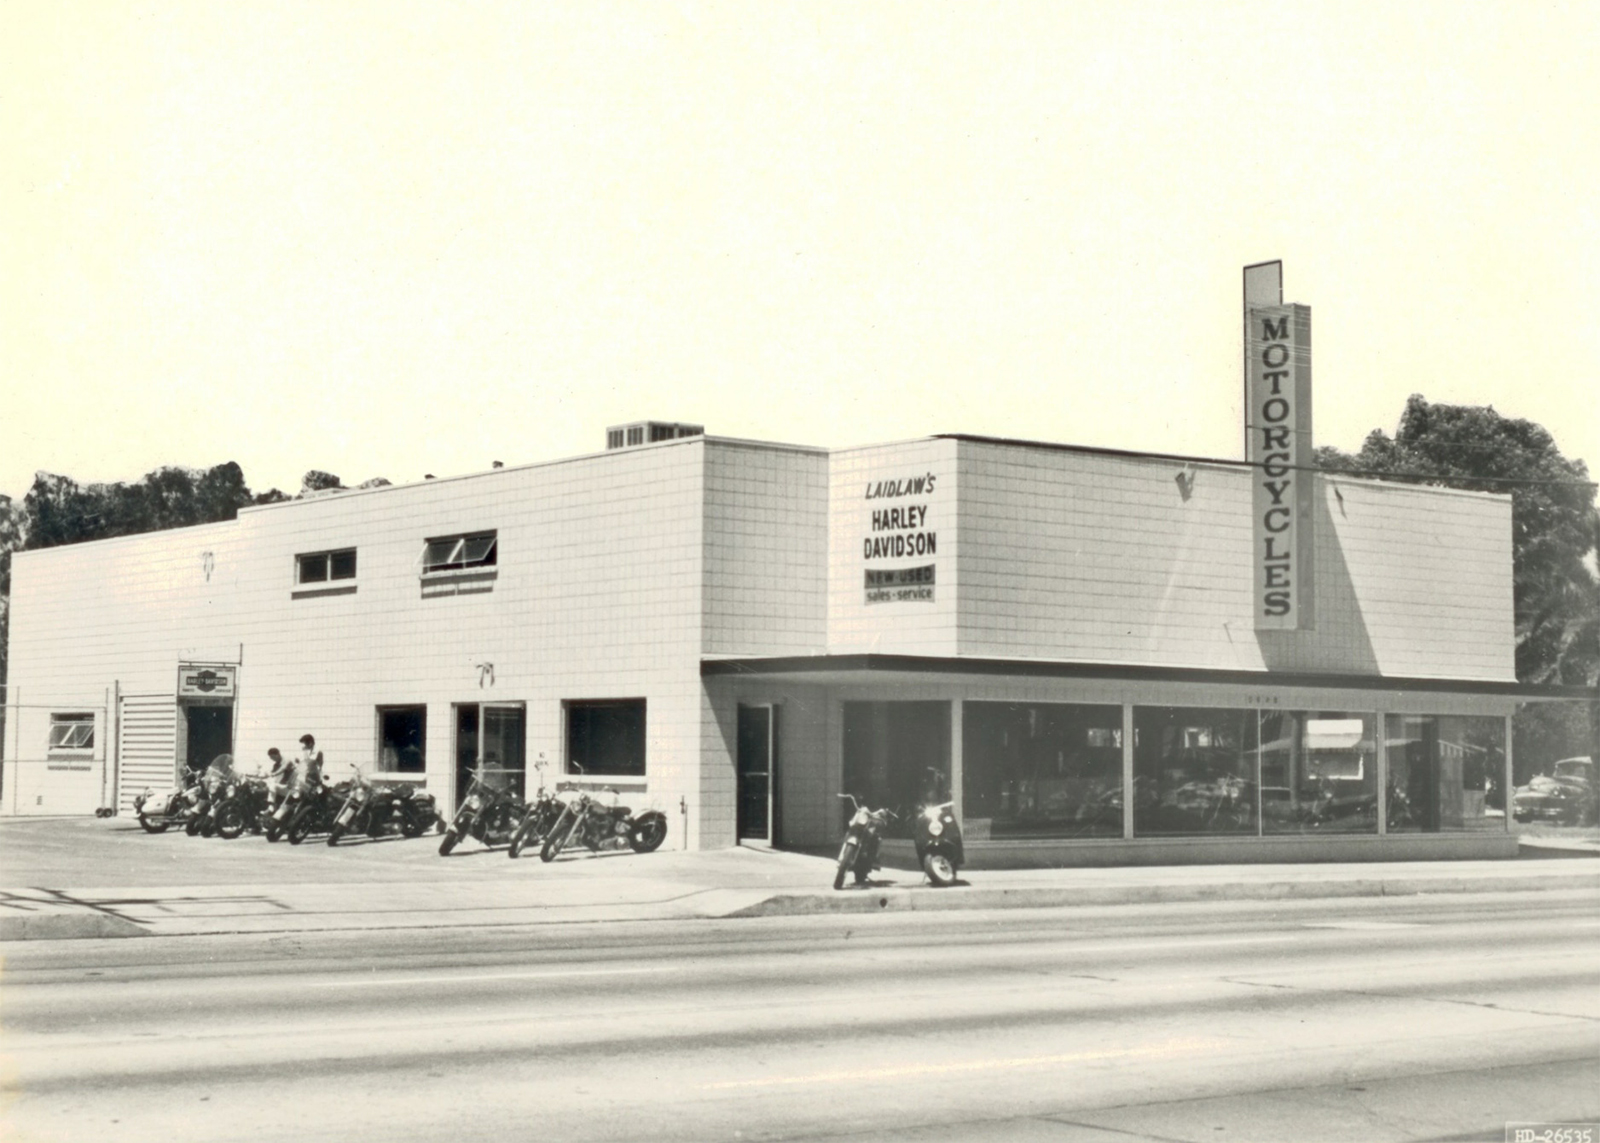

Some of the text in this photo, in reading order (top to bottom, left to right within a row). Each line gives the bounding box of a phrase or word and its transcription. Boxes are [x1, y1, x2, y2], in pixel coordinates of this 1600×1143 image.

[1261, 315, 1291, 617] MOTORCYCLES
[865, 472, 936, 500] LAIDLAW'S
[872, 505, 927, 531] HARLEY
[864, 532, 936, 560] DAVIDSON
